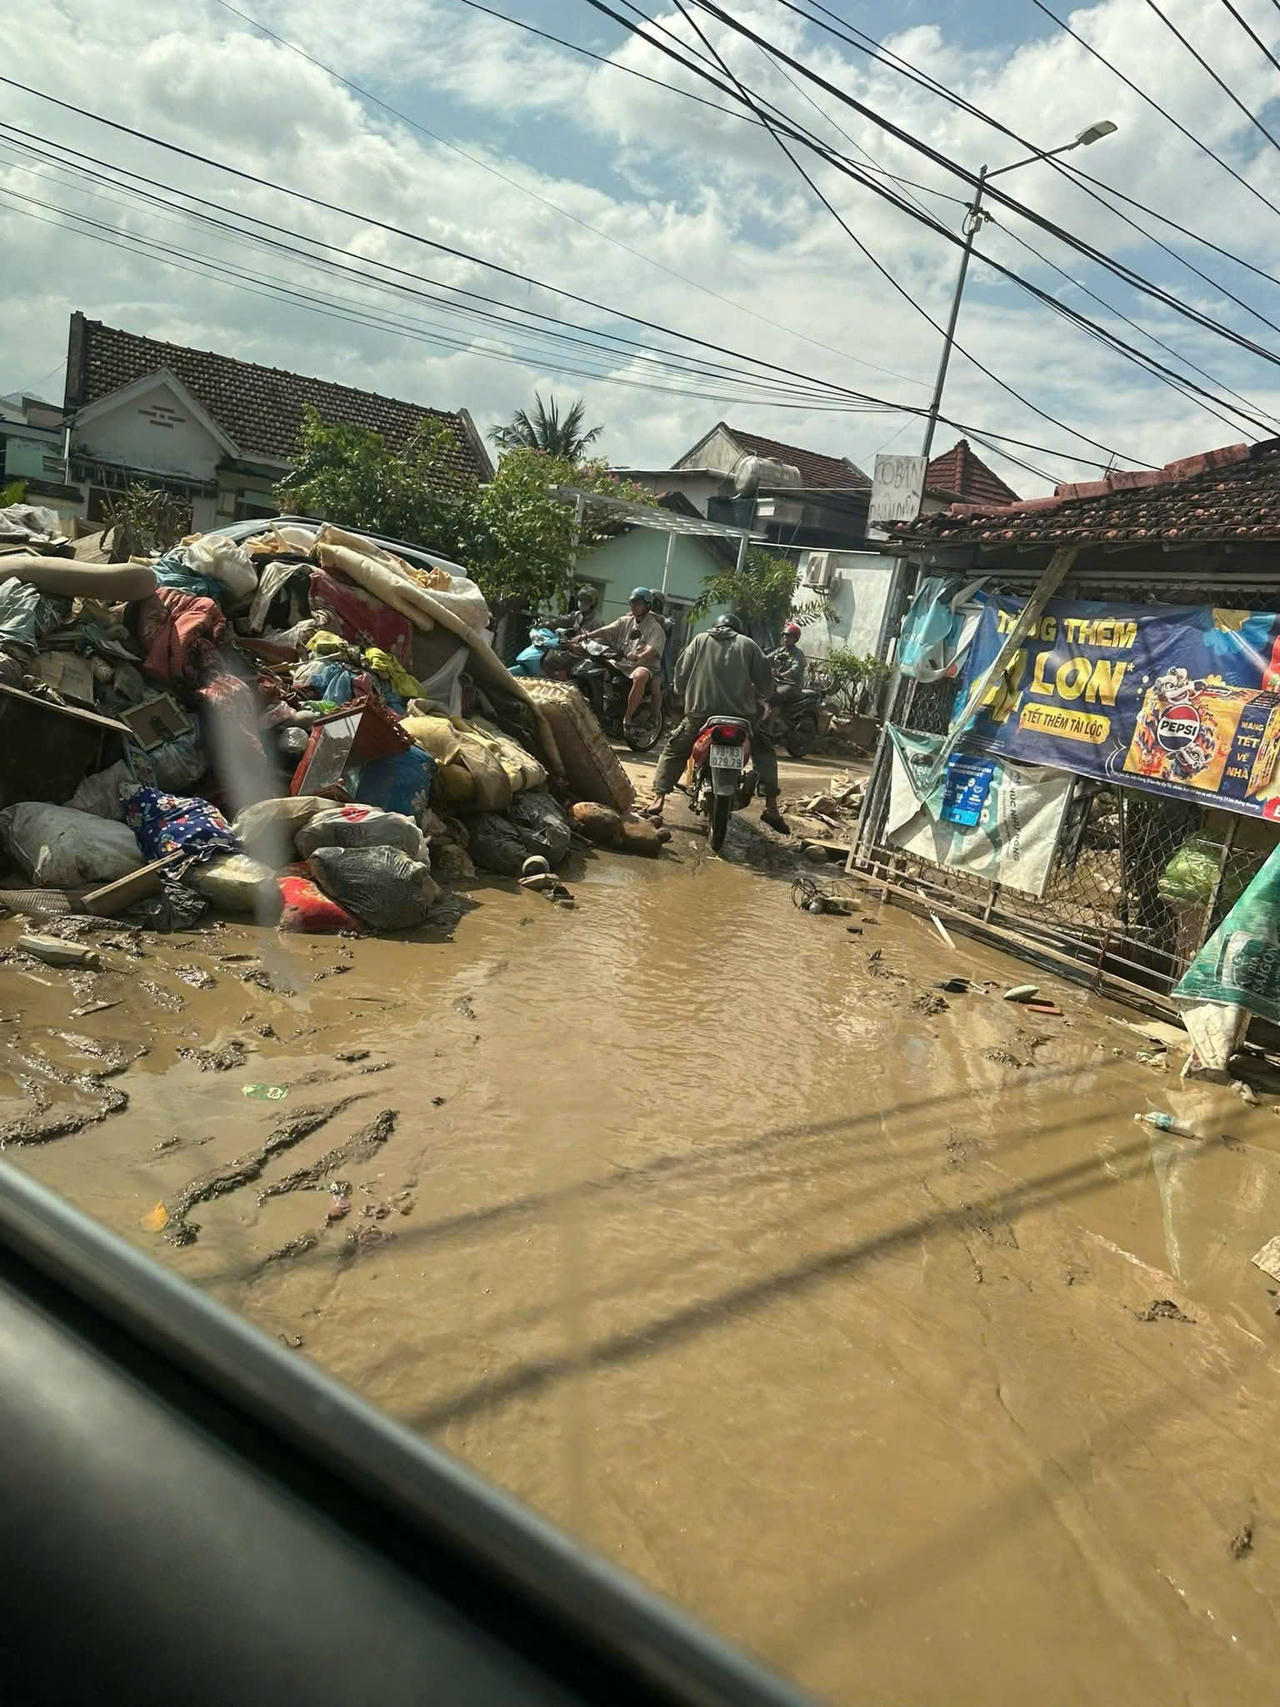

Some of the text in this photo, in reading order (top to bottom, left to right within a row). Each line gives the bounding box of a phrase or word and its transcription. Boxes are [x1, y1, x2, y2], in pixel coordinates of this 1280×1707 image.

[1064, 616, 1138, 648] THÊM
[1027, 708, 1103, 739] TẾT THÊM TÀI LỘC
[1160, 720, 1198, 737] PEPSI
[1240, 721, 1264, 731] MANG
[1236, 734, 1261, 749] TẾT
